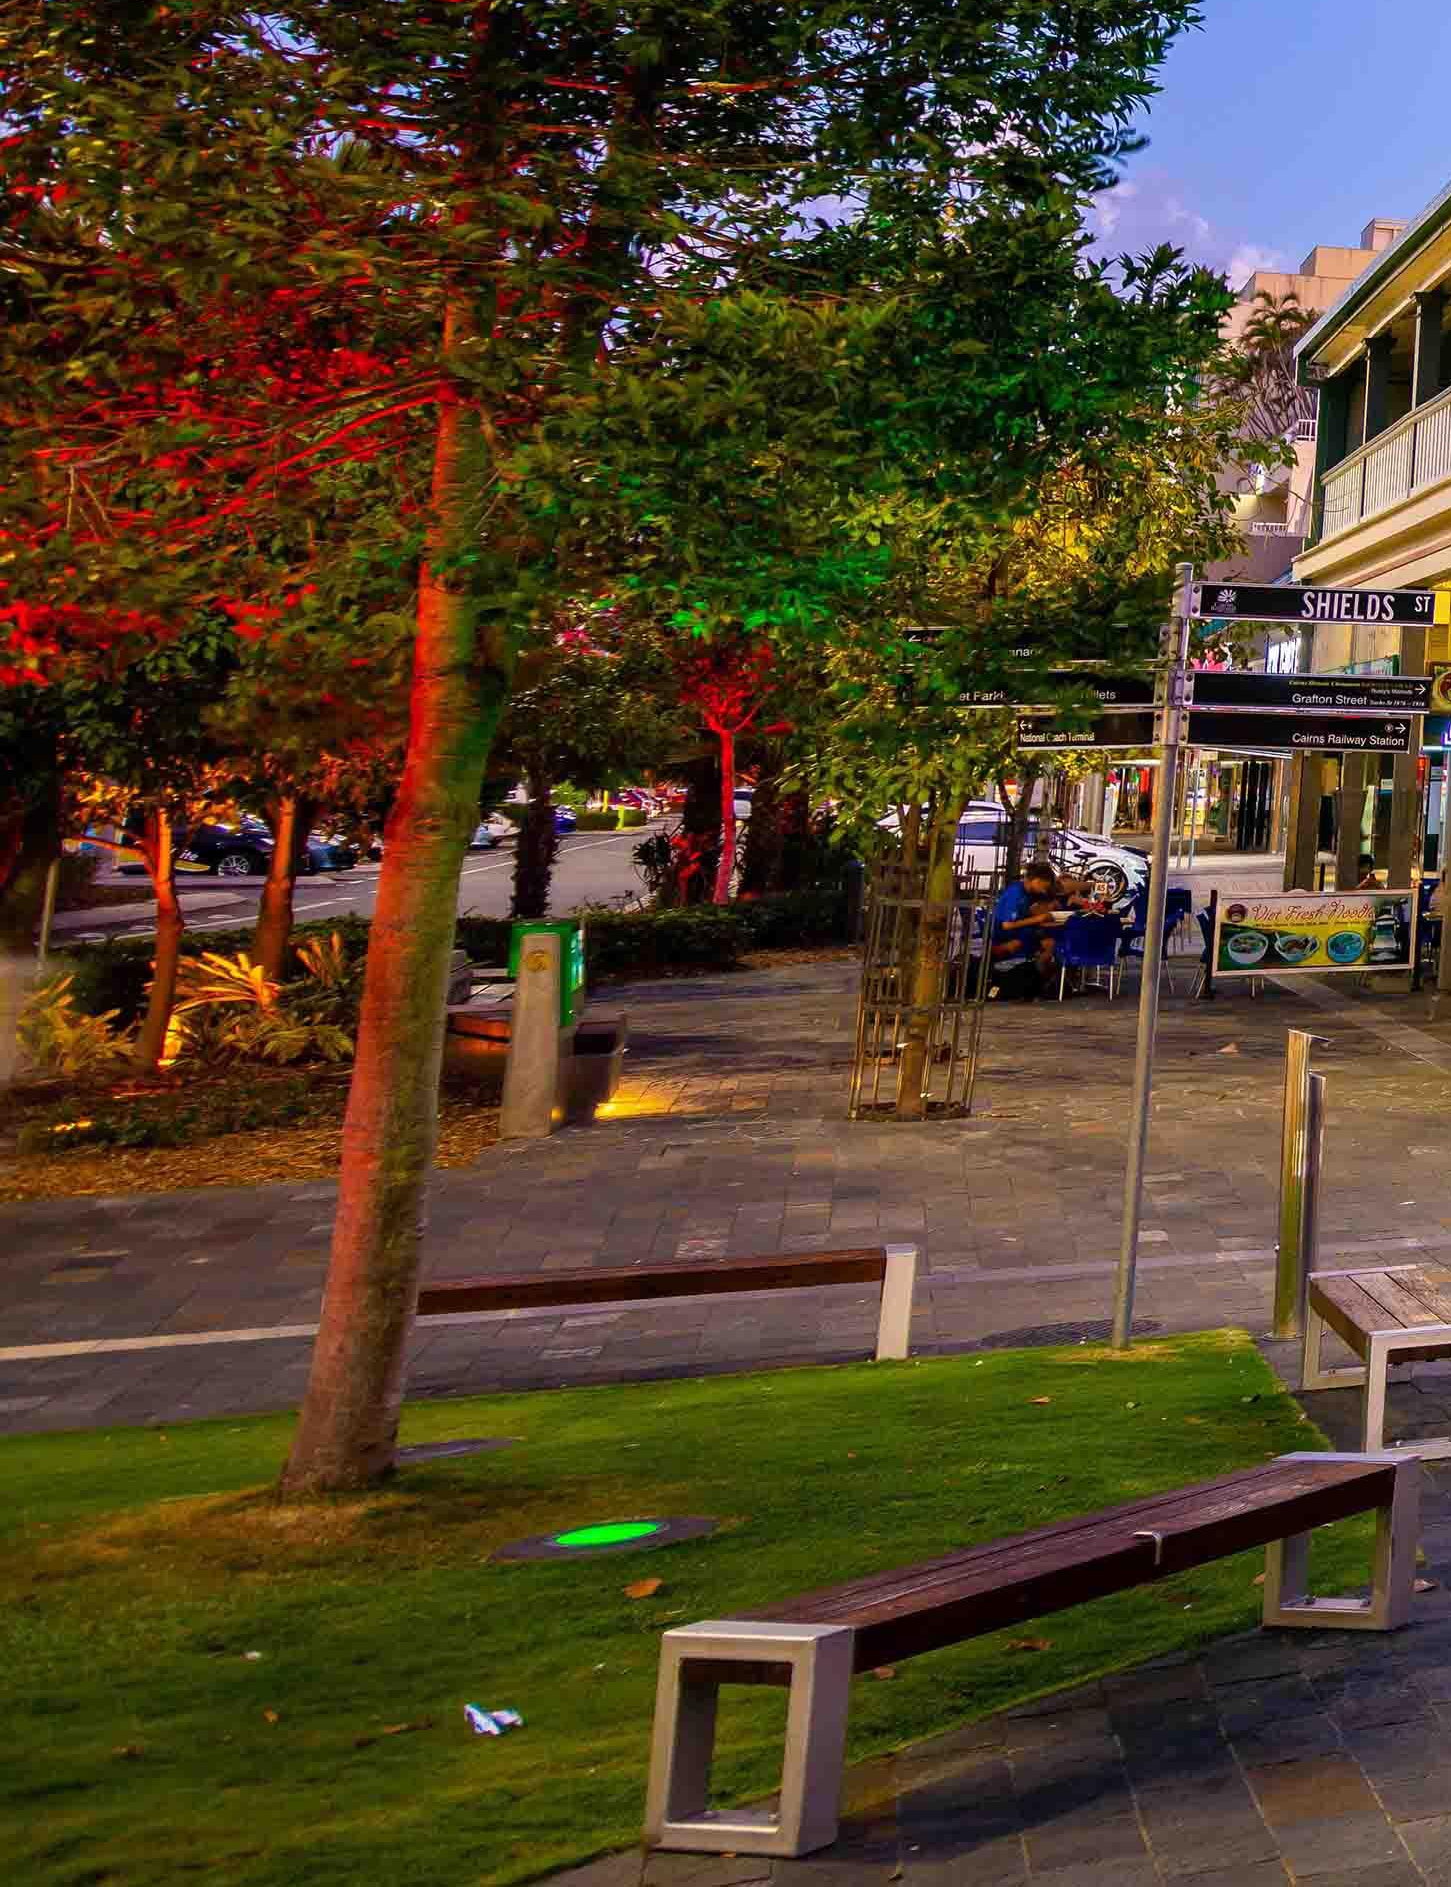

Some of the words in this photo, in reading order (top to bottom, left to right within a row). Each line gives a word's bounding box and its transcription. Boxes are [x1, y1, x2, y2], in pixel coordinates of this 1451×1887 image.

[1301, 591, 1395, 622] SHIELDS
[1414, 596, 1431, 612] ST
[1292, 693, 1334, 704] Grafton
[1335, 695, 1367, 706] Street
[1020, 733, 1045, 743] National
[1047, 732, 1067, 742] Cach
[1292, 732, 1325, 744] Cairns
[1327, 734, 1367, 747] Railway
[1369, 735, 1405, 746] Station
